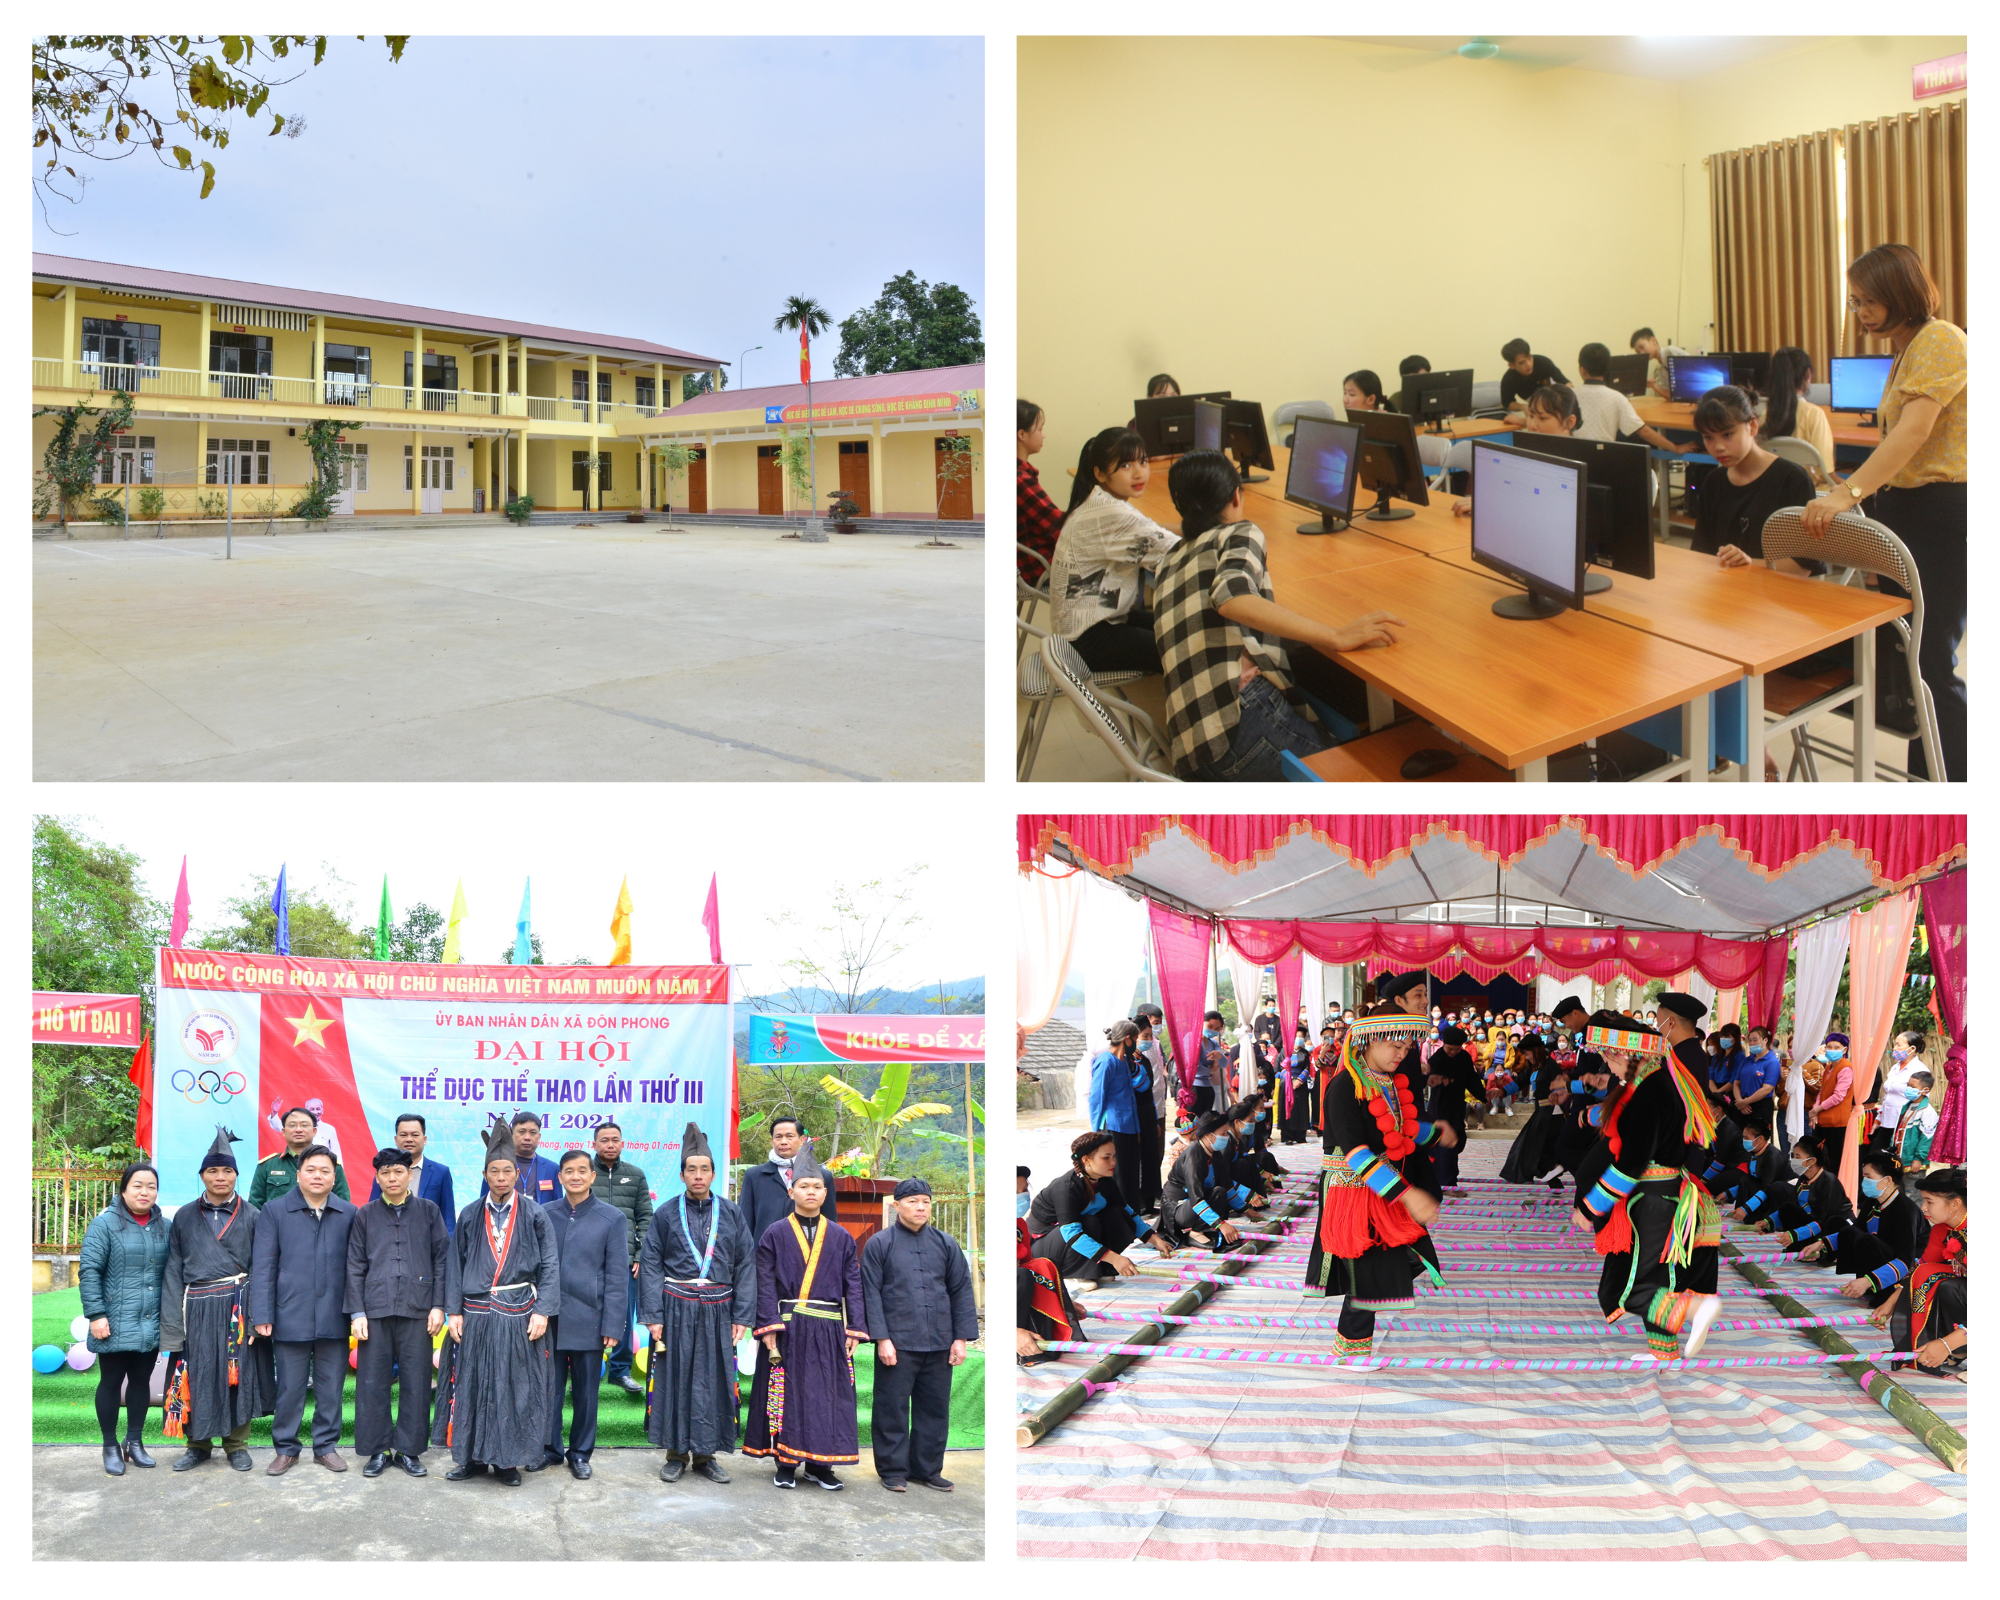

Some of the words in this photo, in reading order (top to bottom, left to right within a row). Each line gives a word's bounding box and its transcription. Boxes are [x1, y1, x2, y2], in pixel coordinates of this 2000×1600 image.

[1922, 63, 1954, 89] THẦY
[856, 404, 871, 414] CHUNG
[173, 961, 226, 982] NƯỚC
[232, 964, 284, 986] CỘNG
[290, 966, 328, 987] HÒA
[332, 967, 357, 990] XÃ
[364, 971, 394, 993] HỘI
[400, 971, 437, 992] CHỦ
[443, 975, 498, 993] NGHĨA
[504, 975, 542, 997] VIỆT
[548, 979, 590, 994] NAM
[596, 976, 650, 995] MUÔN
[656, 976, 699, 995] NĂM
[706, 979, 711, 994] !
[40, 1001, 64, 1031] HỒ
[69, 1005, 87, 1032] VĨ
[91, 1010, 120, 1039] ĐẠI
[127, 1012, 132, 1034] !
[436, 1010, 452, 1026] ỦY
[457, 1015, 484, 1027] BAN
[488, 1013, 526, 1028] NHÂN
[531, 1013, 559, 1028] DÂN
[564, 1014, 583, 1028] XÃ
[587, 1014, 618, 1028] ĐÔN
[621, 1017, 670, 1029] PHONG
[846, 1026, 910, 1048] KHỎE
[917, 1024, 950, 1048] ĐỂ
[474, 1040, 545, 1066] ĐẠI
[558, 1034, 631, 1068] HỘI
[400, 1068, 439, 1100] THỂ
[444, 1077, 484, 1107] DỤC
[491, 1069, 530, 1102] THỂ
[535, 1079, 587, 1103] THAO
[593, 1071, 632, 1103] LẦN
[639, 1073, 680, 1104] THỨ
[684, 1080, 704, 1104] III
[560, 1113, 614, 1129] 2021
[564, 1140, 584, 1151] ngày
[627, 1140, 649, 1152] tháng
[652, 1141, 660, 1150] 01
[663, 1141, 680, 1150] năm
